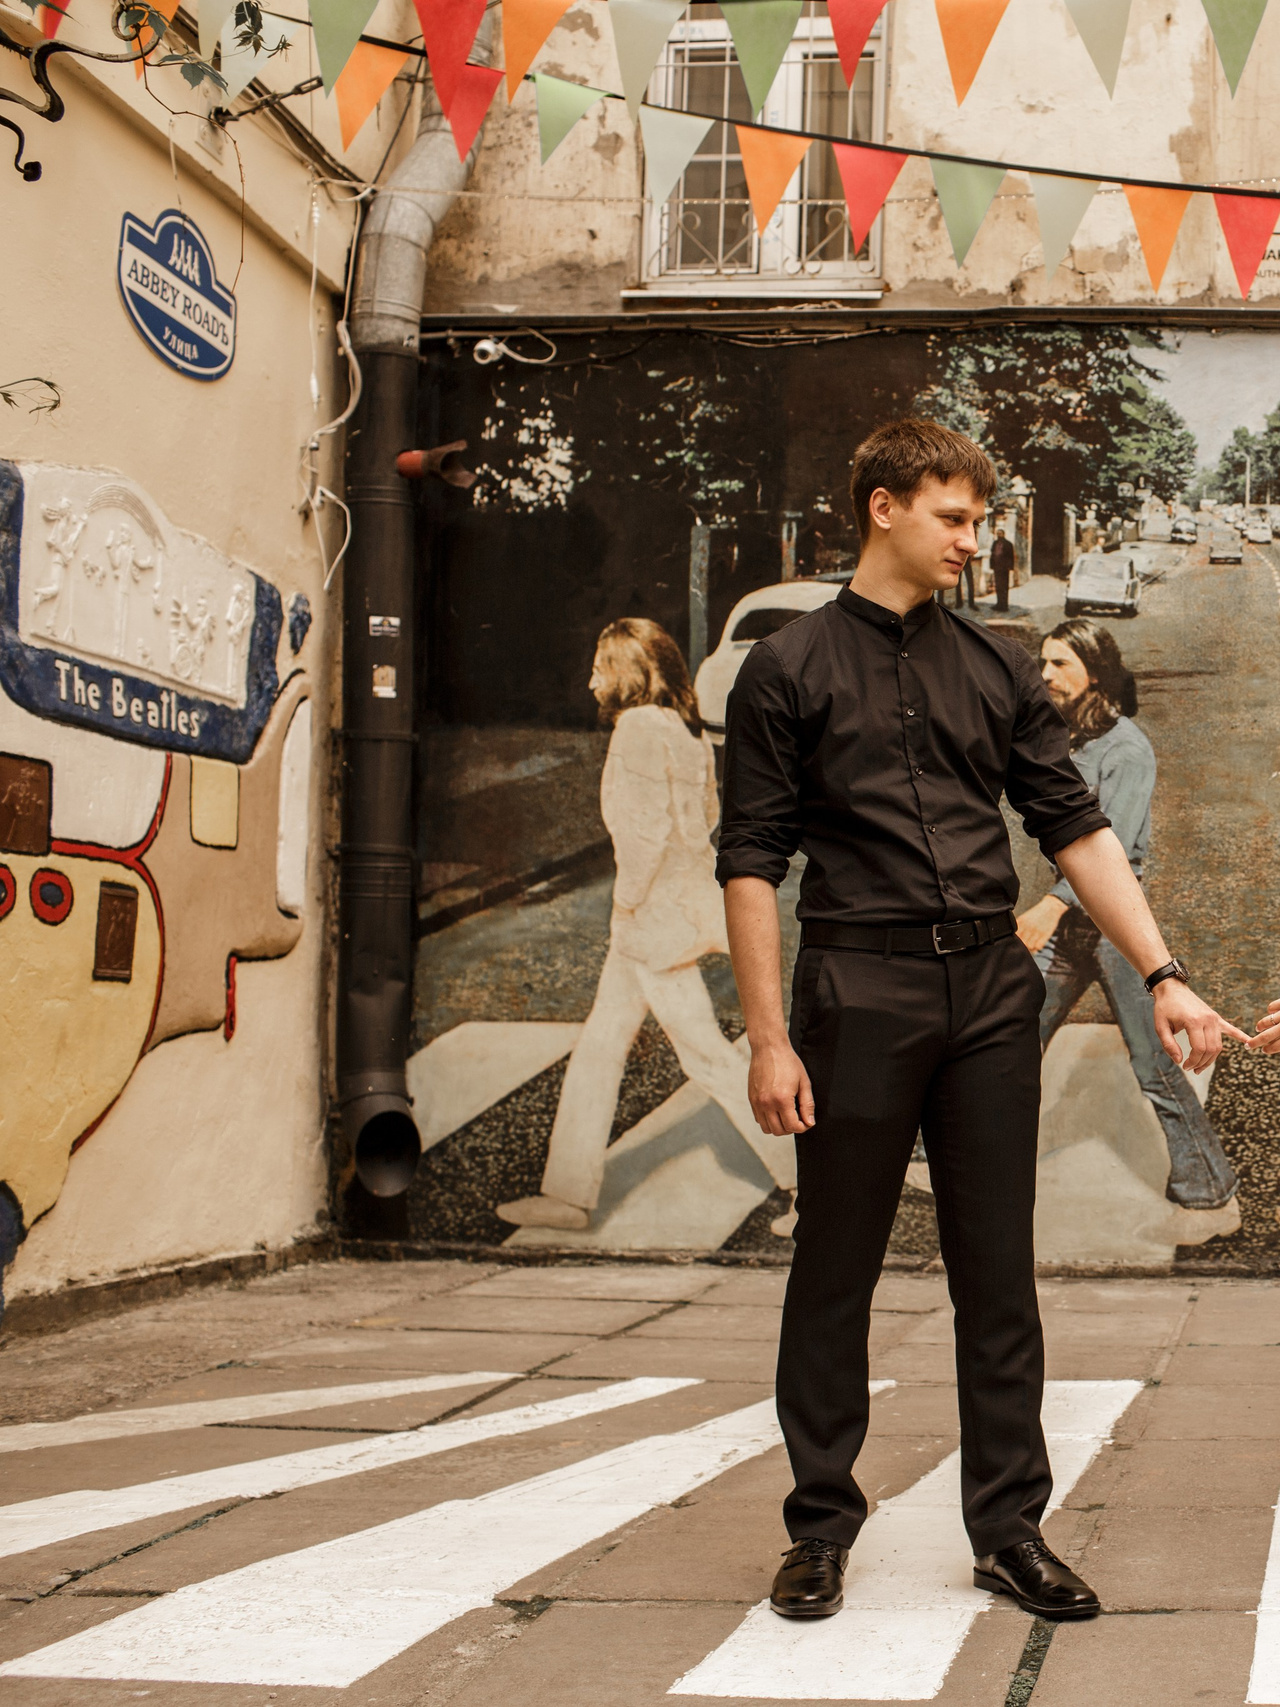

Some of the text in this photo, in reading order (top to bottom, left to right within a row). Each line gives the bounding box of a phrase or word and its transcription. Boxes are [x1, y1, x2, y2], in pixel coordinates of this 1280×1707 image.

[127, 258, 181, 309] ABBEY
[162, 325, 199, 361] УЛИЦА
[54, 658, 200, 739] The Beatles
